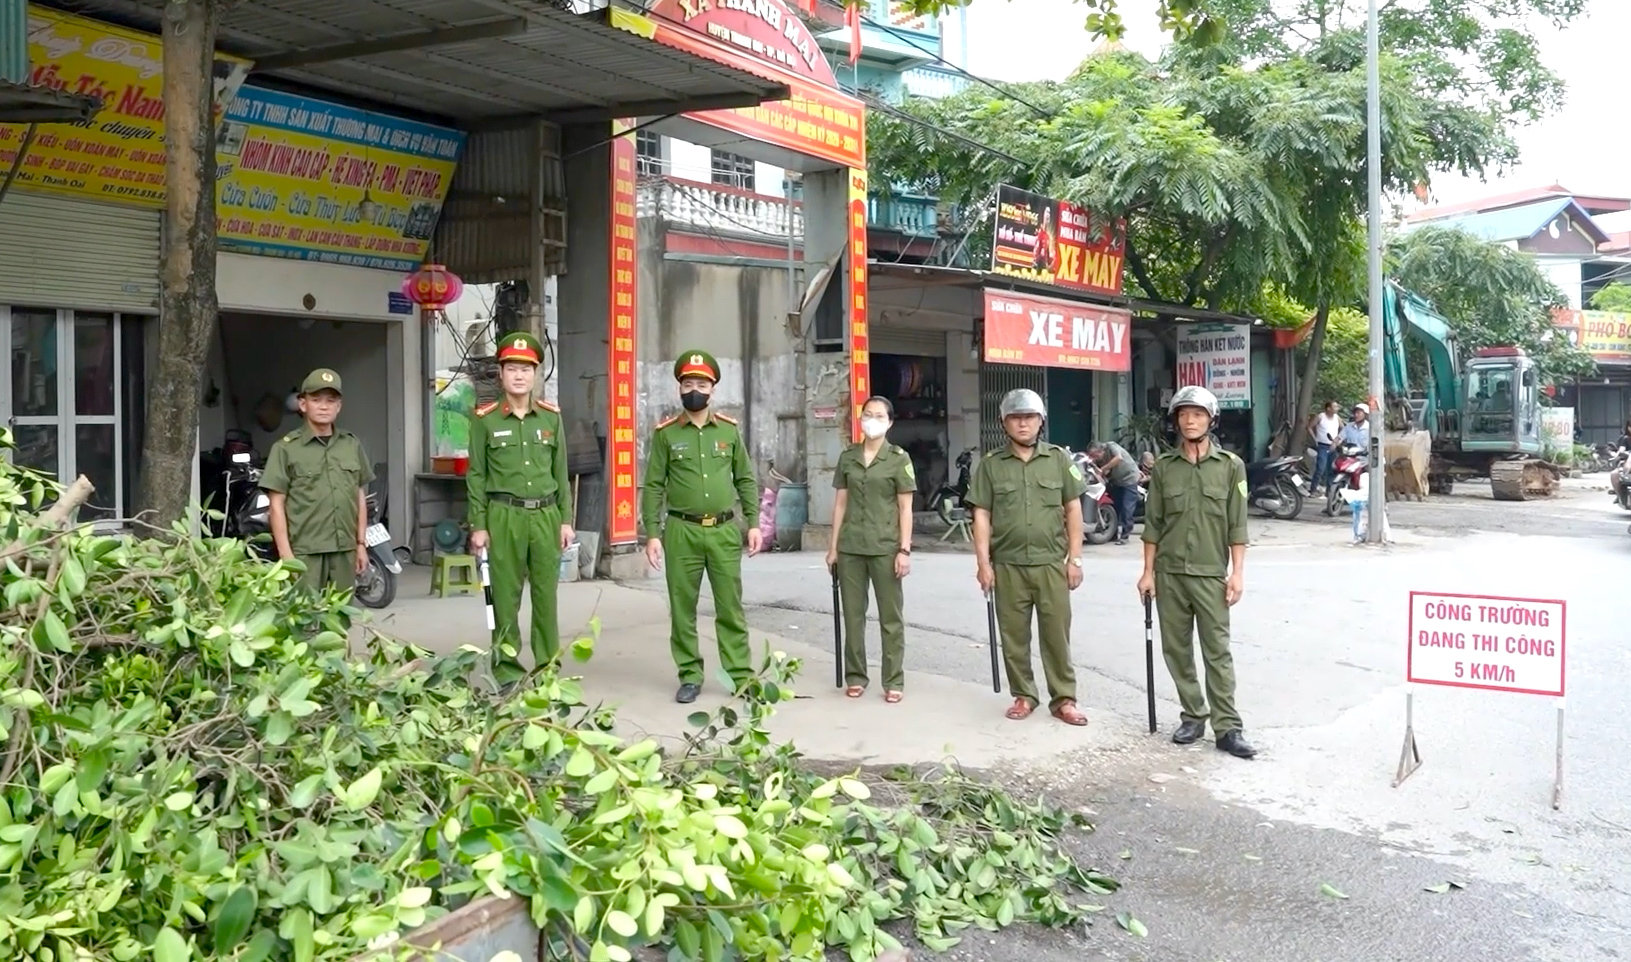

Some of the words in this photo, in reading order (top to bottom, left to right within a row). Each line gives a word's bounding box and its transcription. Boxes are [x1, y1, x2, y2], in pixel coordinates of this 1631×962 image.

[115, 84, 166, 121] Nam
[100, 119, 156, 140] chuyên
[228, 96, 250, 117] ÔNG
[250, 101, 264, 119] TY
[263, 103, 290, 125] TNHH
[288, 102, 310, 129] SẢN
[308, 108, 334, 133] XUẤT
[381, 127, 391, 144] &
[770, 109, 784, 130] CÁC
[783, 112, 797, 133] CẤP
[42, 175, 67, 186] Thanh
[221, 181, 246, 206] Cửa
[288, 191, 311, 216] Cửa
[1056, 243, 1080, 282] XE
[1082, 246, 1121, 290] MÁY
[1027, 310, 1064, 348] XE
[1071, 313, 1126, 354] MÁY
[1227, 333, 1246, 351] NƯỚC
[1179, 355, 1206, 388] HÀN
[1425, 600, 1472, 622] CÔNG
[1478, 603, 1550, 627] TRƯỜNG
[1419, 630, 1465, 650] ĐANG
[1472, 634, 1498, 652] THI
[1505, 634, 1555, 657] CÔNG
[1455, 662, 1464, 678] 5
[1470, 663, 1515, 683] KM/h
